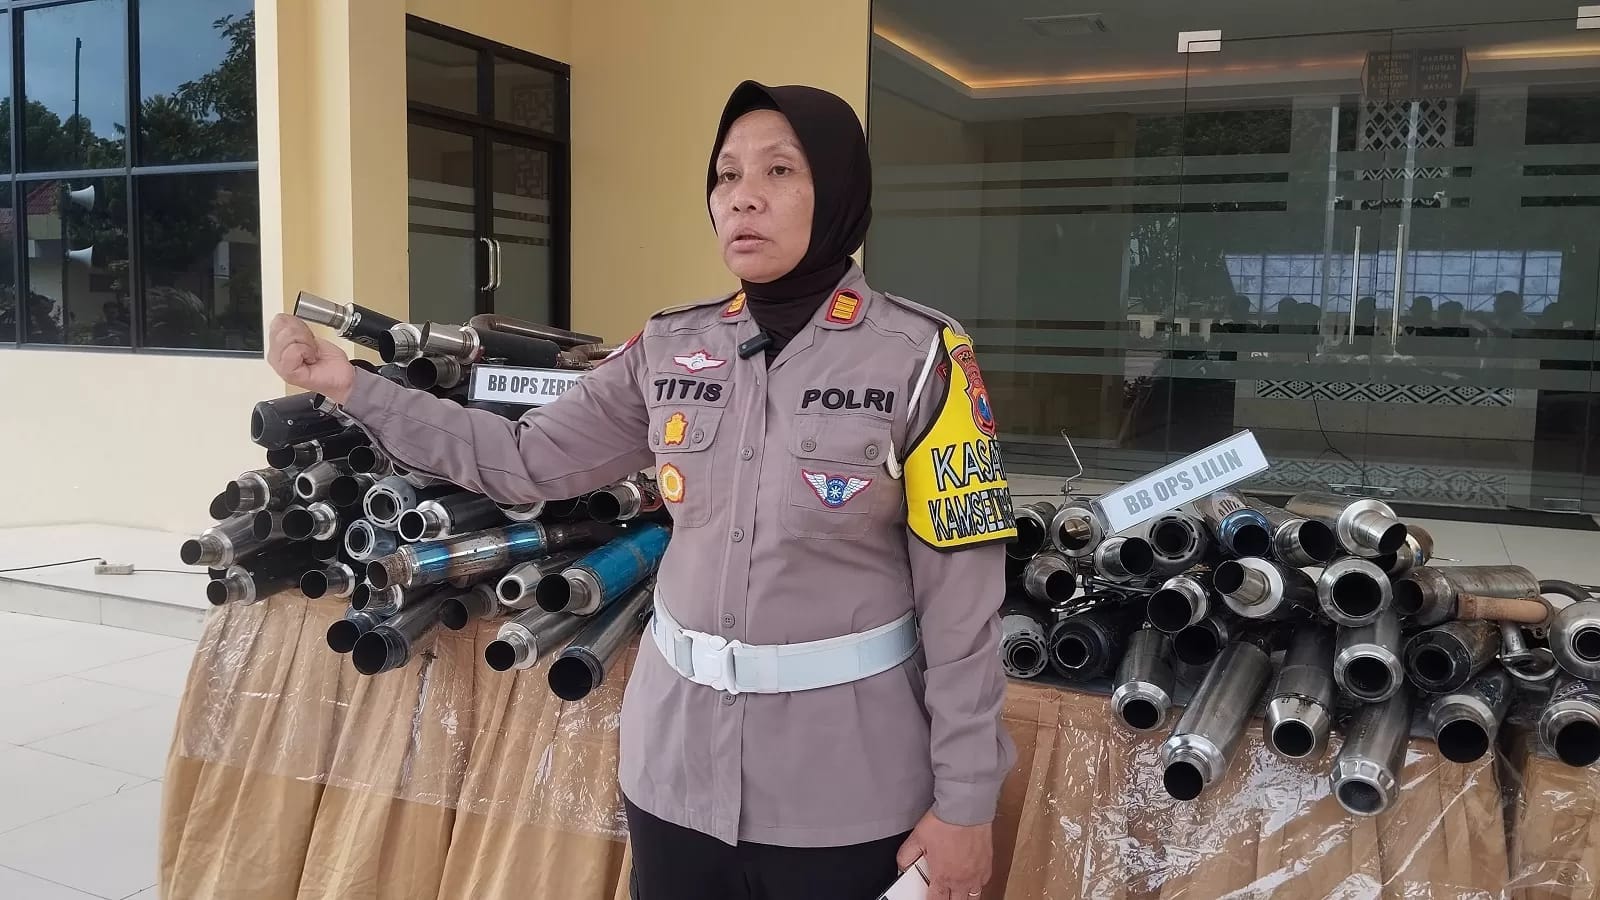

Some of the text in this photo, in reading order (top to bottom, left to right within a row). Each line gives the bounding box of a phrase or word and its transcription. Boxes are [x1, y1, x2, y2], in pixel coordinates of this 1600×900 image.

[487, 374, 508, 392] BB
[510, 375, 539, 395] OPS
[654, 378, 723, 402] TITIS
[801, 388, 895, 413] POLRI
[931, 438, 1007, 492] KASA
[1122, 448, 1244, 516] BB OPS LILIN
